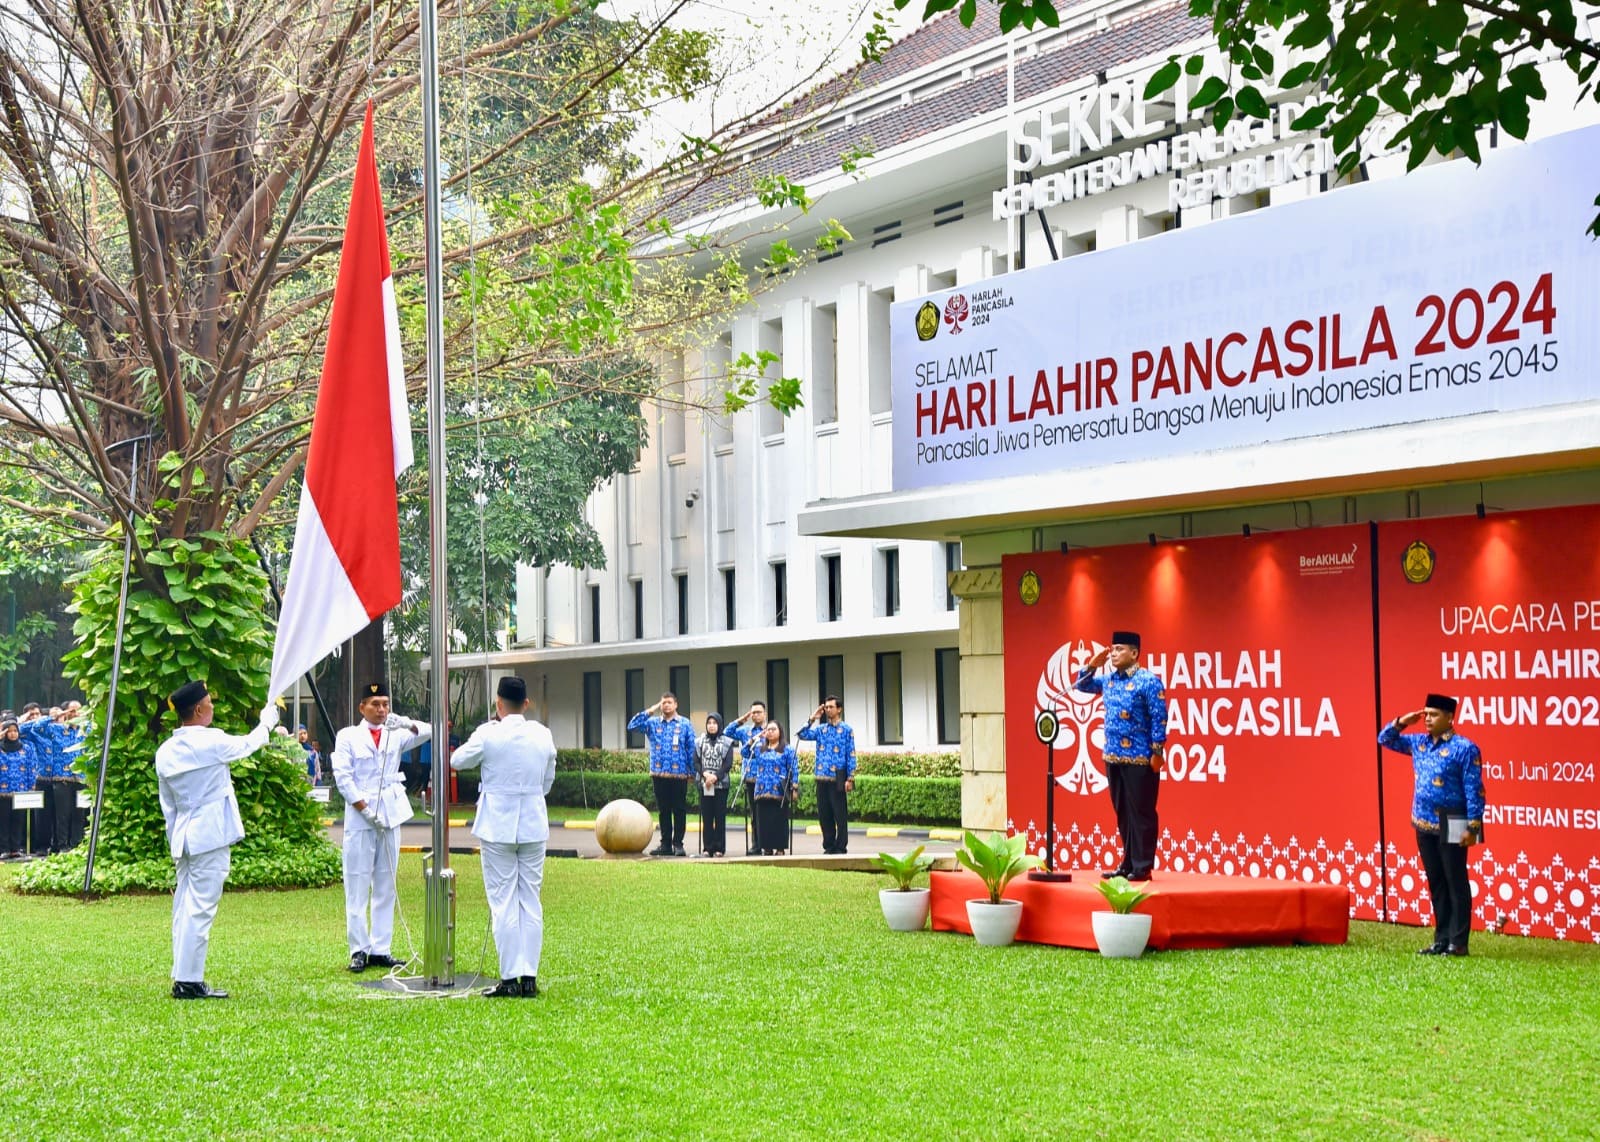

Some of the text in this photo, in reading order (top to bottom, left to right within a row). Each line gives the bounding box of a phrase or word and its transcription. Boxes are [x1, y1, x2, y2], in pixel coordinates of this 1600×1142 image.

[993, 141, 1167, 221] KEMENTERIAN
[1170, 142, 1313, 213] REPUBLIK
[971, 287, 1003, 304] HARLAH
[971, 296, 1014, 315] PANCASILA
[971, 313, 990, 326] 2024
[915, 348, 998, 388] SELAMAT
[916, 379, 996, 438] HARI
[1008, 357, 1118, 423] LAHIR
[1132, 306, 1398, 402] PANCASILA
[1414, 272, 1557, 357] 2024
[917, 340, 1559, 465] Pancasila Jiwa Pemersatu Bangsa Menuju Indonesia Emas 2045
[1299, 546, 1357, 567] BerAKHLAK
[1440, 600, 1600, 636] UPACARA PE
[1147, 649, 1282, 690] HARLAH
[1441, 648, 1600, 680] HARI LAHIR
[1165, 697, 1341, 737] ANCASILA
[1451, 695, 1600, 727] AHUN 202
[1508, 760, 1514, 780] 1
[1517, 760, 1549, 781] Juni
[1552, 761, 1595, 783] 2024
[1482, 804, 1600, 830] ENTERIAN ES
